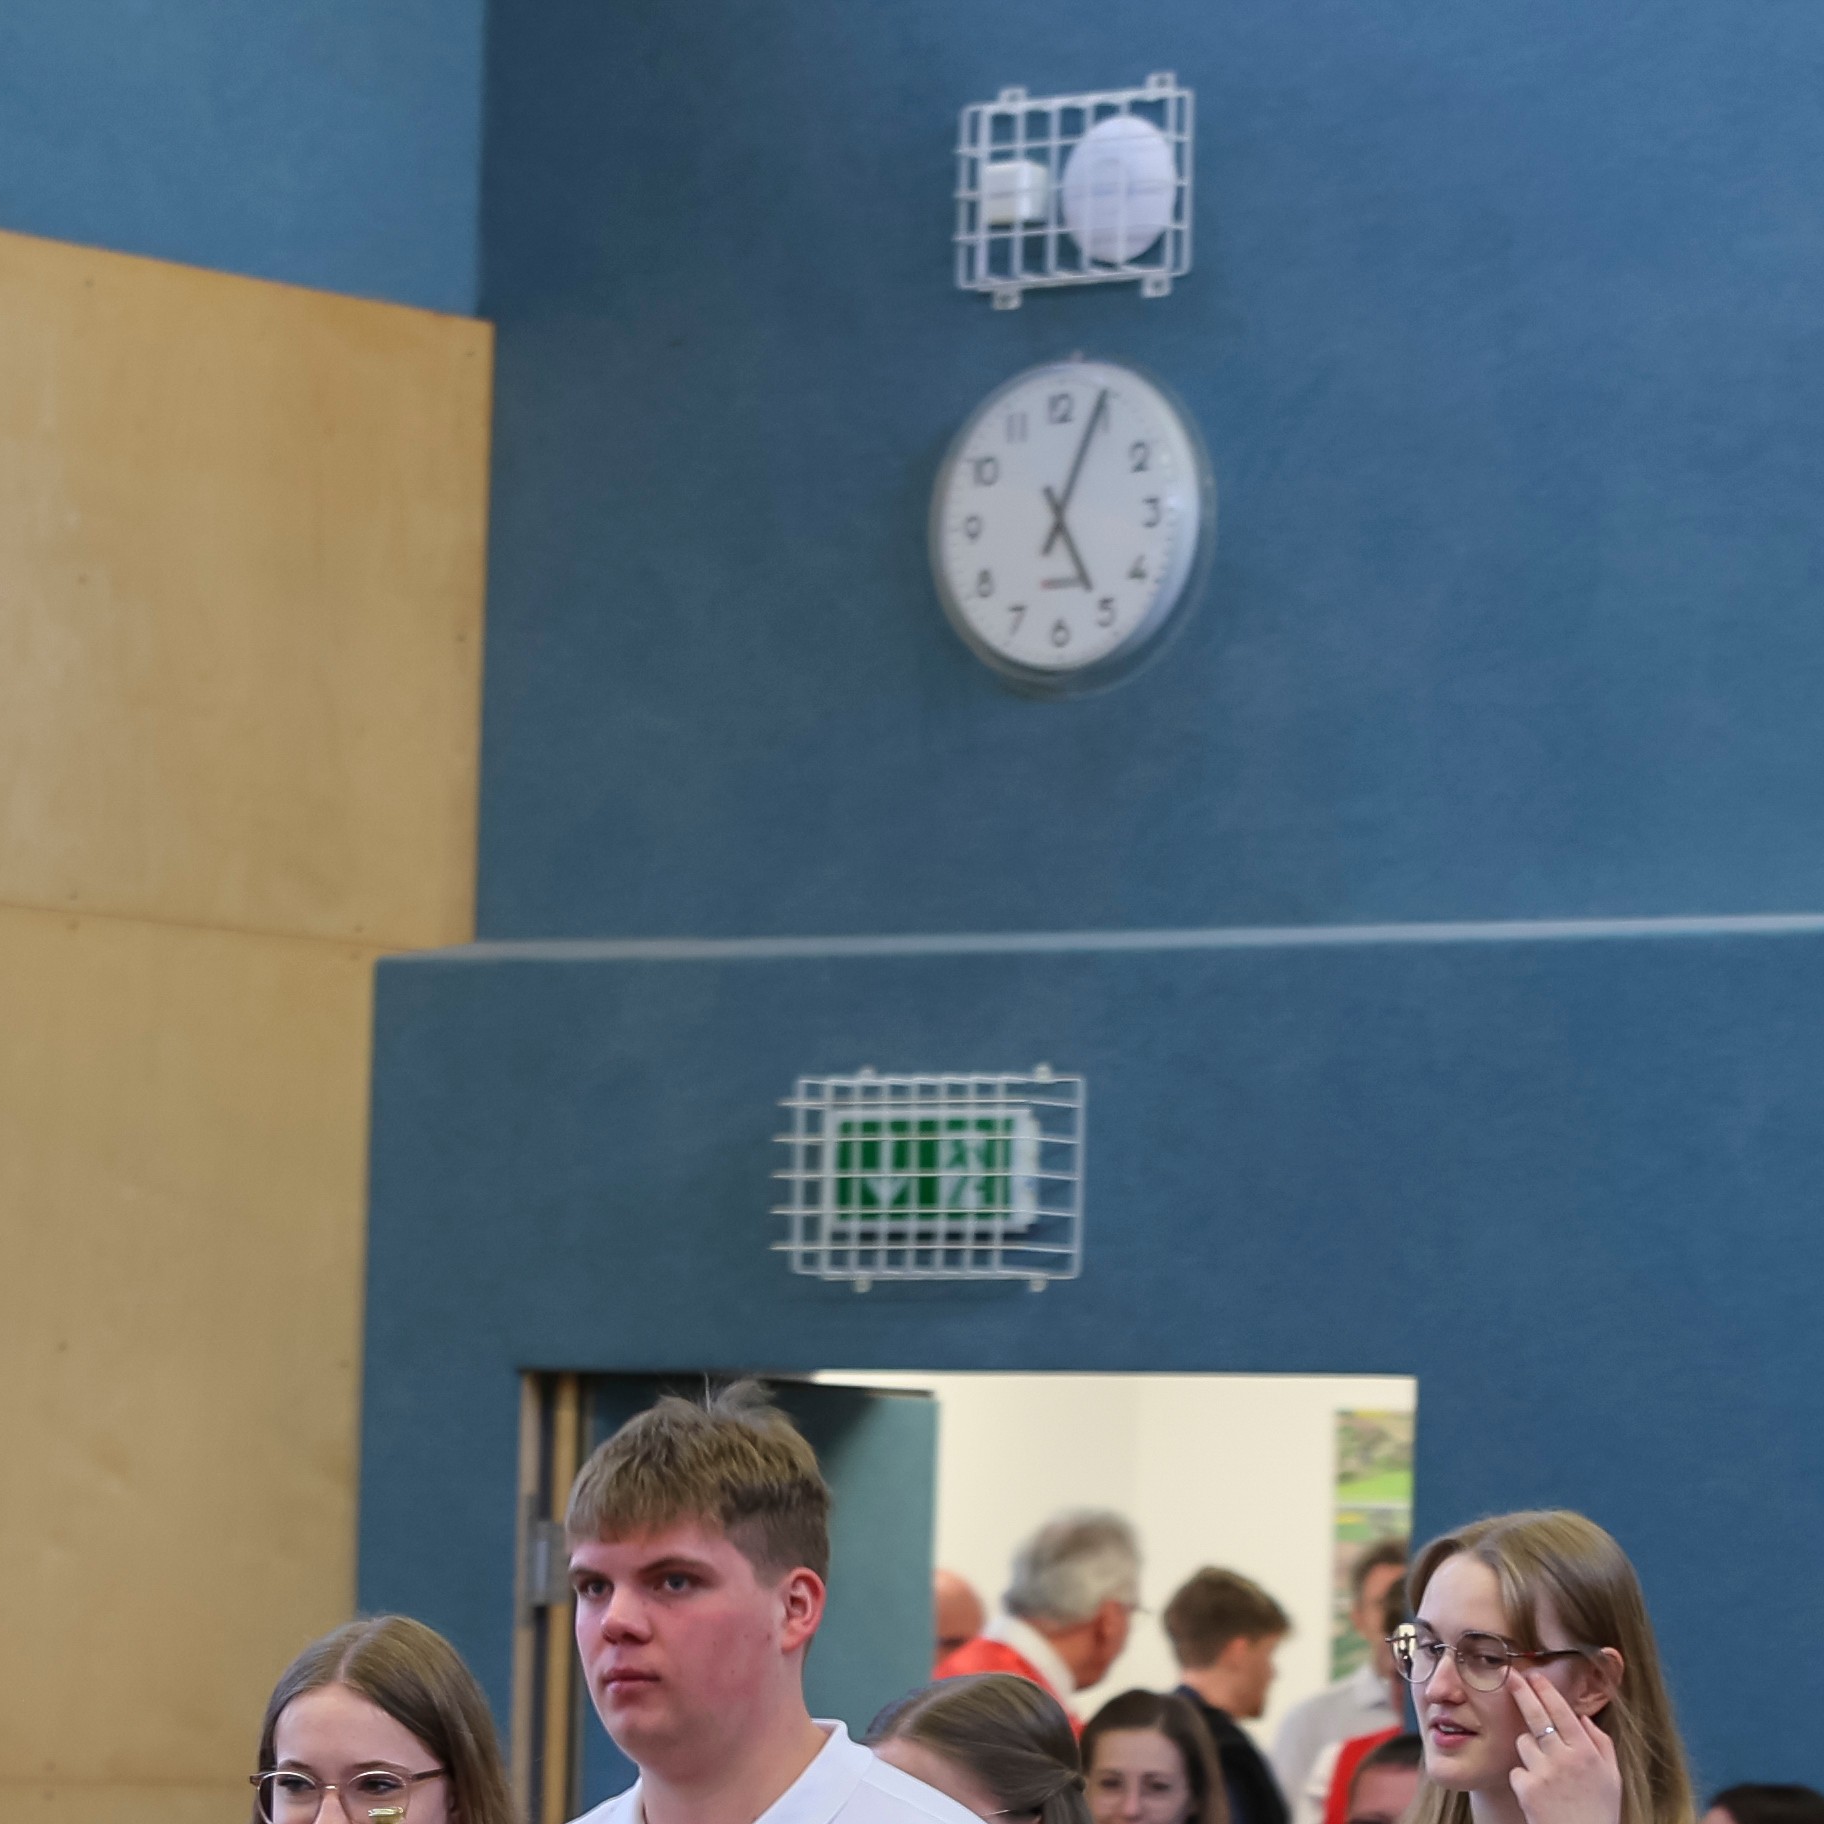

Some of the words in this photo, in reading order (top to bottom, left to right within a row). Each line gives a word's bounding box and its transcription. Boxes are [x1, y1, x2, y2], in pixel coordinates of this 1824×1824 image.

[1047, 392, 1074, 424] 12
[1005, 411, 1029, 443] 11
[973, 455, 1000, 487] 10
[1128, 441, 1150, 474] 2
[964, 514, 983, 541] 9
[1141, 497, 1161, 528] 3
[1126, 555, 1147, 580] 4
[977, 569, 994, 599] 8
[1008, 604, 1028, 635] 7
[1097, 597, 1116, 627] 5
[1050, 616, 1070, 647] 6
